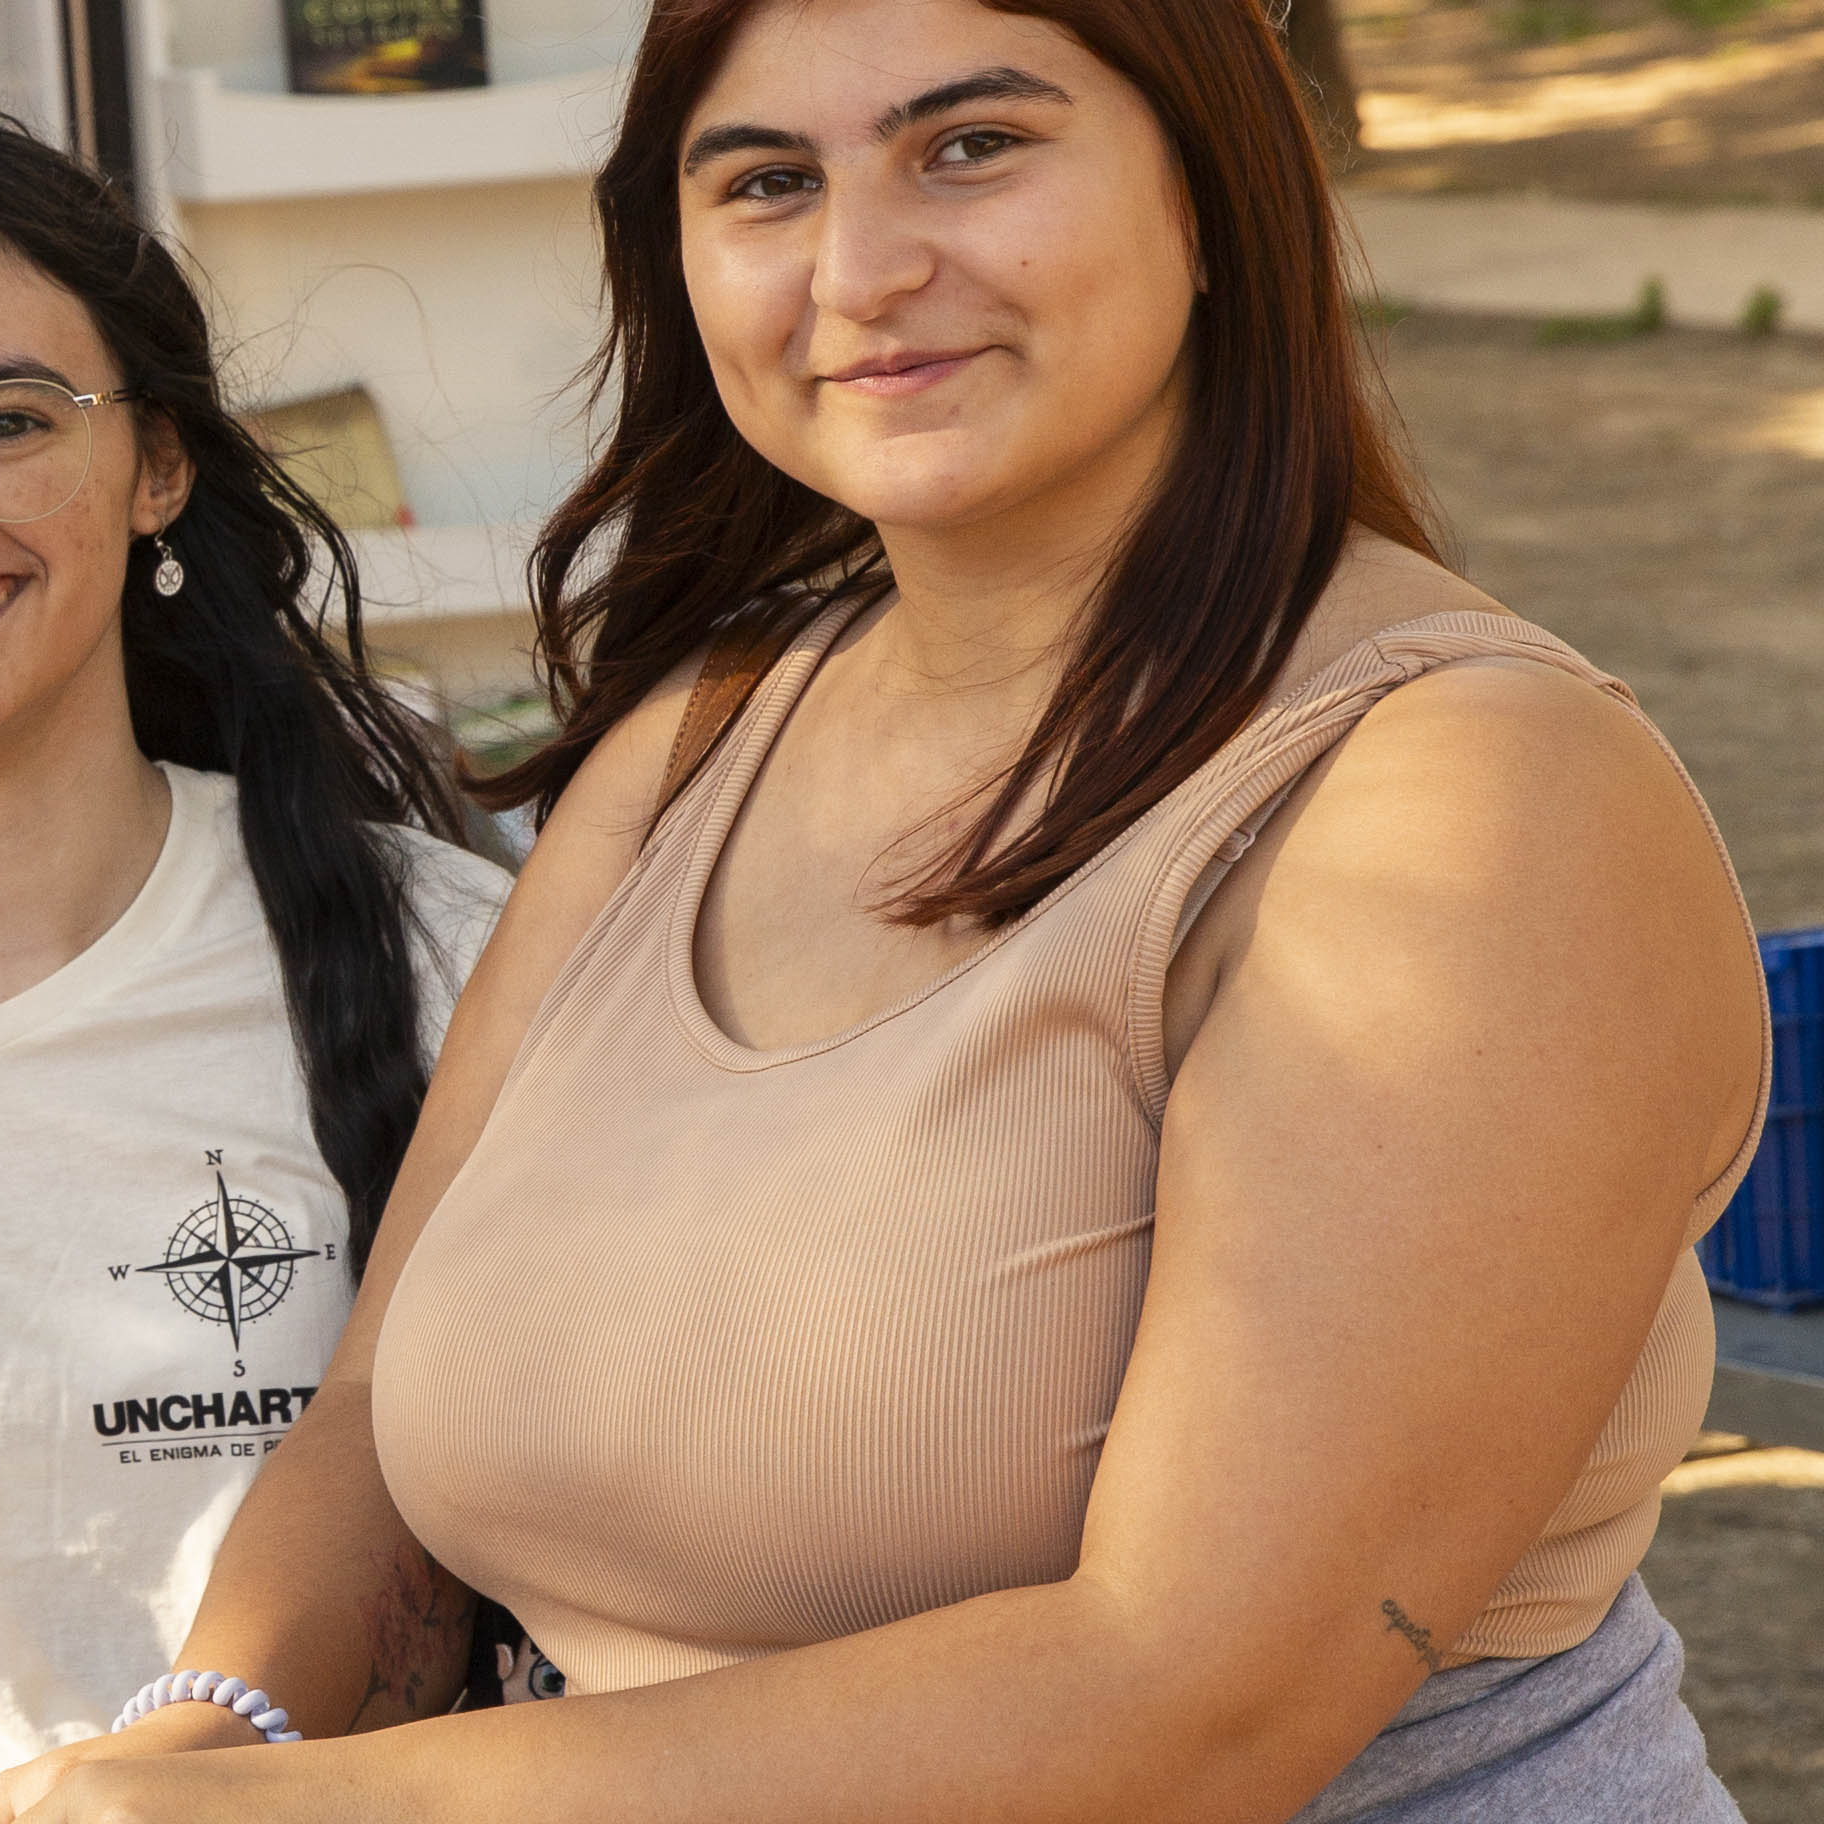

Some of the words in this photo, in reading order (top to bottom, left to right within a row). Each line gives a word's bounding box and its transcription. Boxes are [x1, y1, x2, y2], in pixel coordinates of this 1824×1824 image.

[205, 1149, 224, 1166] N
[324, 1243, 337, 1261] E
[107, 1263, 131, 1282] W
[233, 1359, 246, 1378] S
[119, 1449, 142, 1465] EL
[150, 1445, 222, 1462] ENIGMA
[230, 1442, 256, 1457] DE
